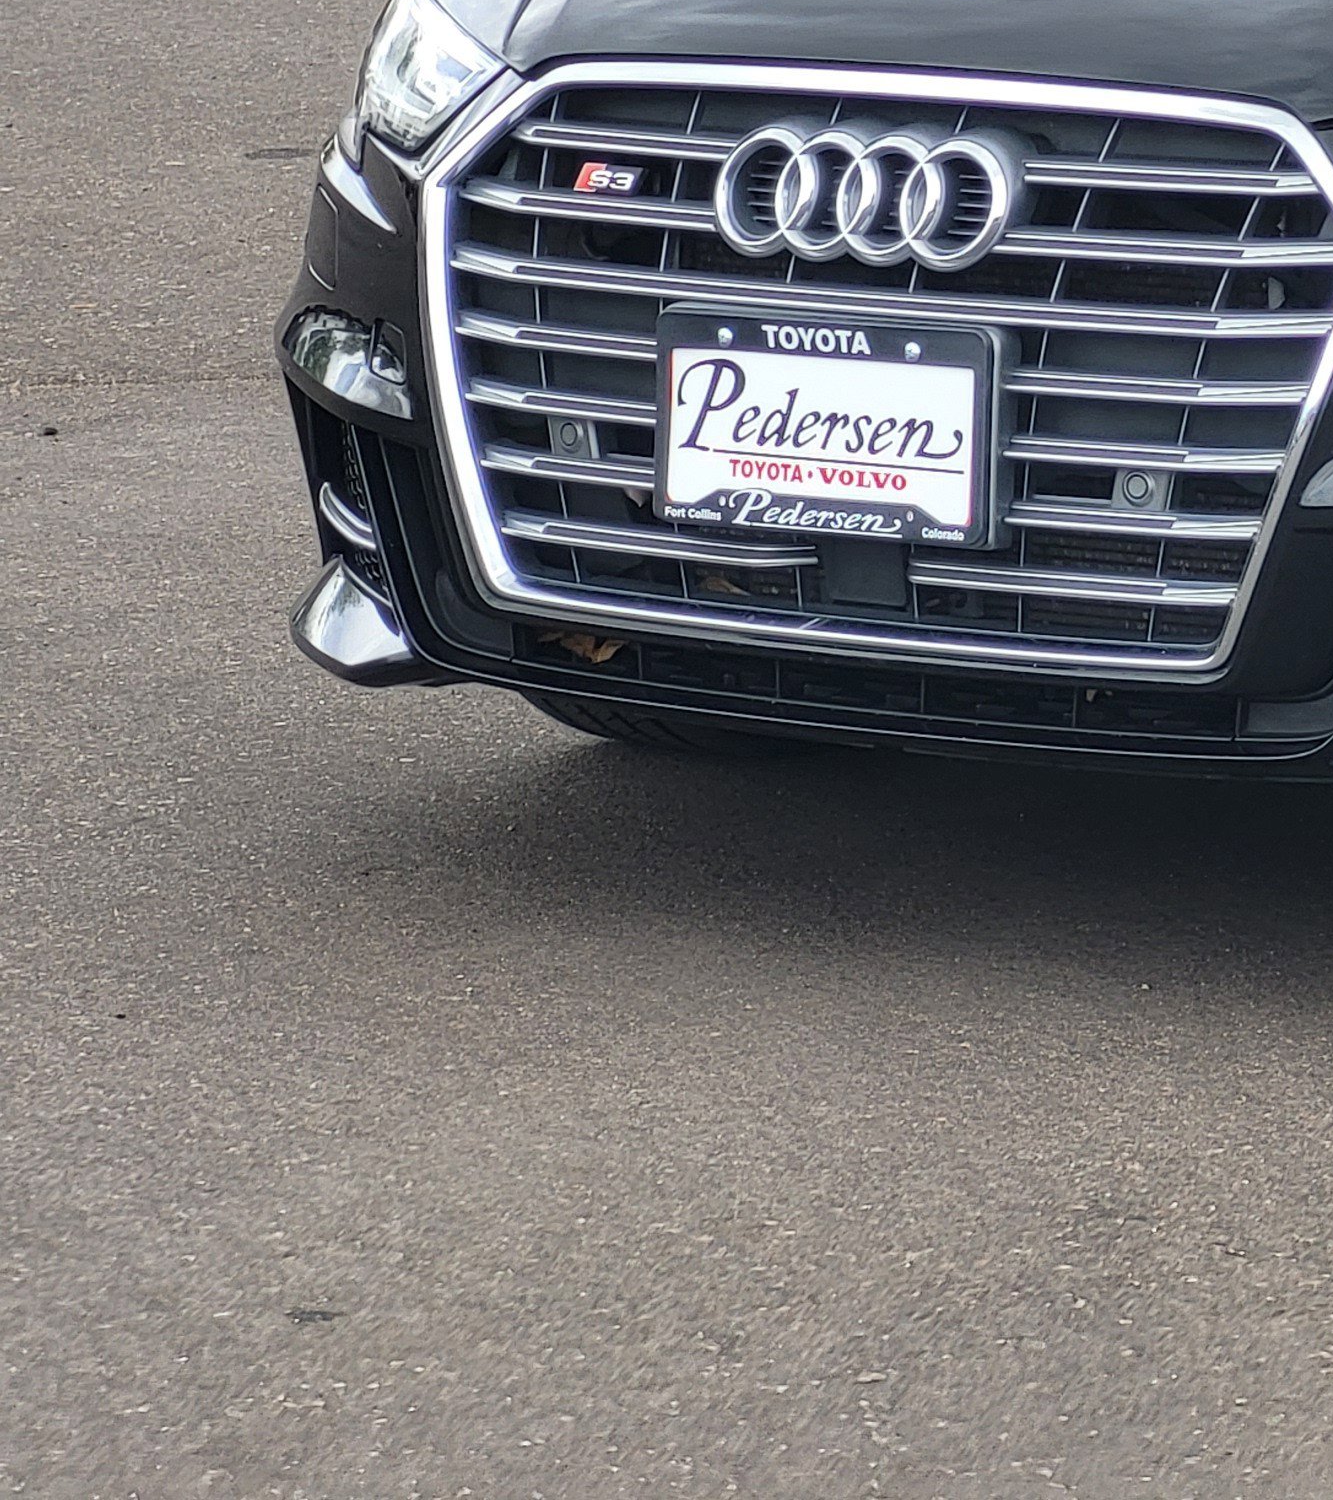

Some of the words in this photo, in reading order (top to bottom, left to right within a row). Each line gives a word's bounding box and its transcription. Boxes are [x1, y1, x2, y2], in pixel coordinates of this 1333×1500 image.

[586, 169, 635, 191] S3
[761, 324, 871, 356] TOYOTA
[678, 358, 963, 459] Pedersen
[729, 459, 803, 483] TOYOTA
[817, 467, 907, 490] VOLVO
[664, 505, 686, 518] Fort
[687, 507, 722, 522] Collins
[728, 489, 902, 532] Pedersen
[921, 526, 965, 541] Colorado
